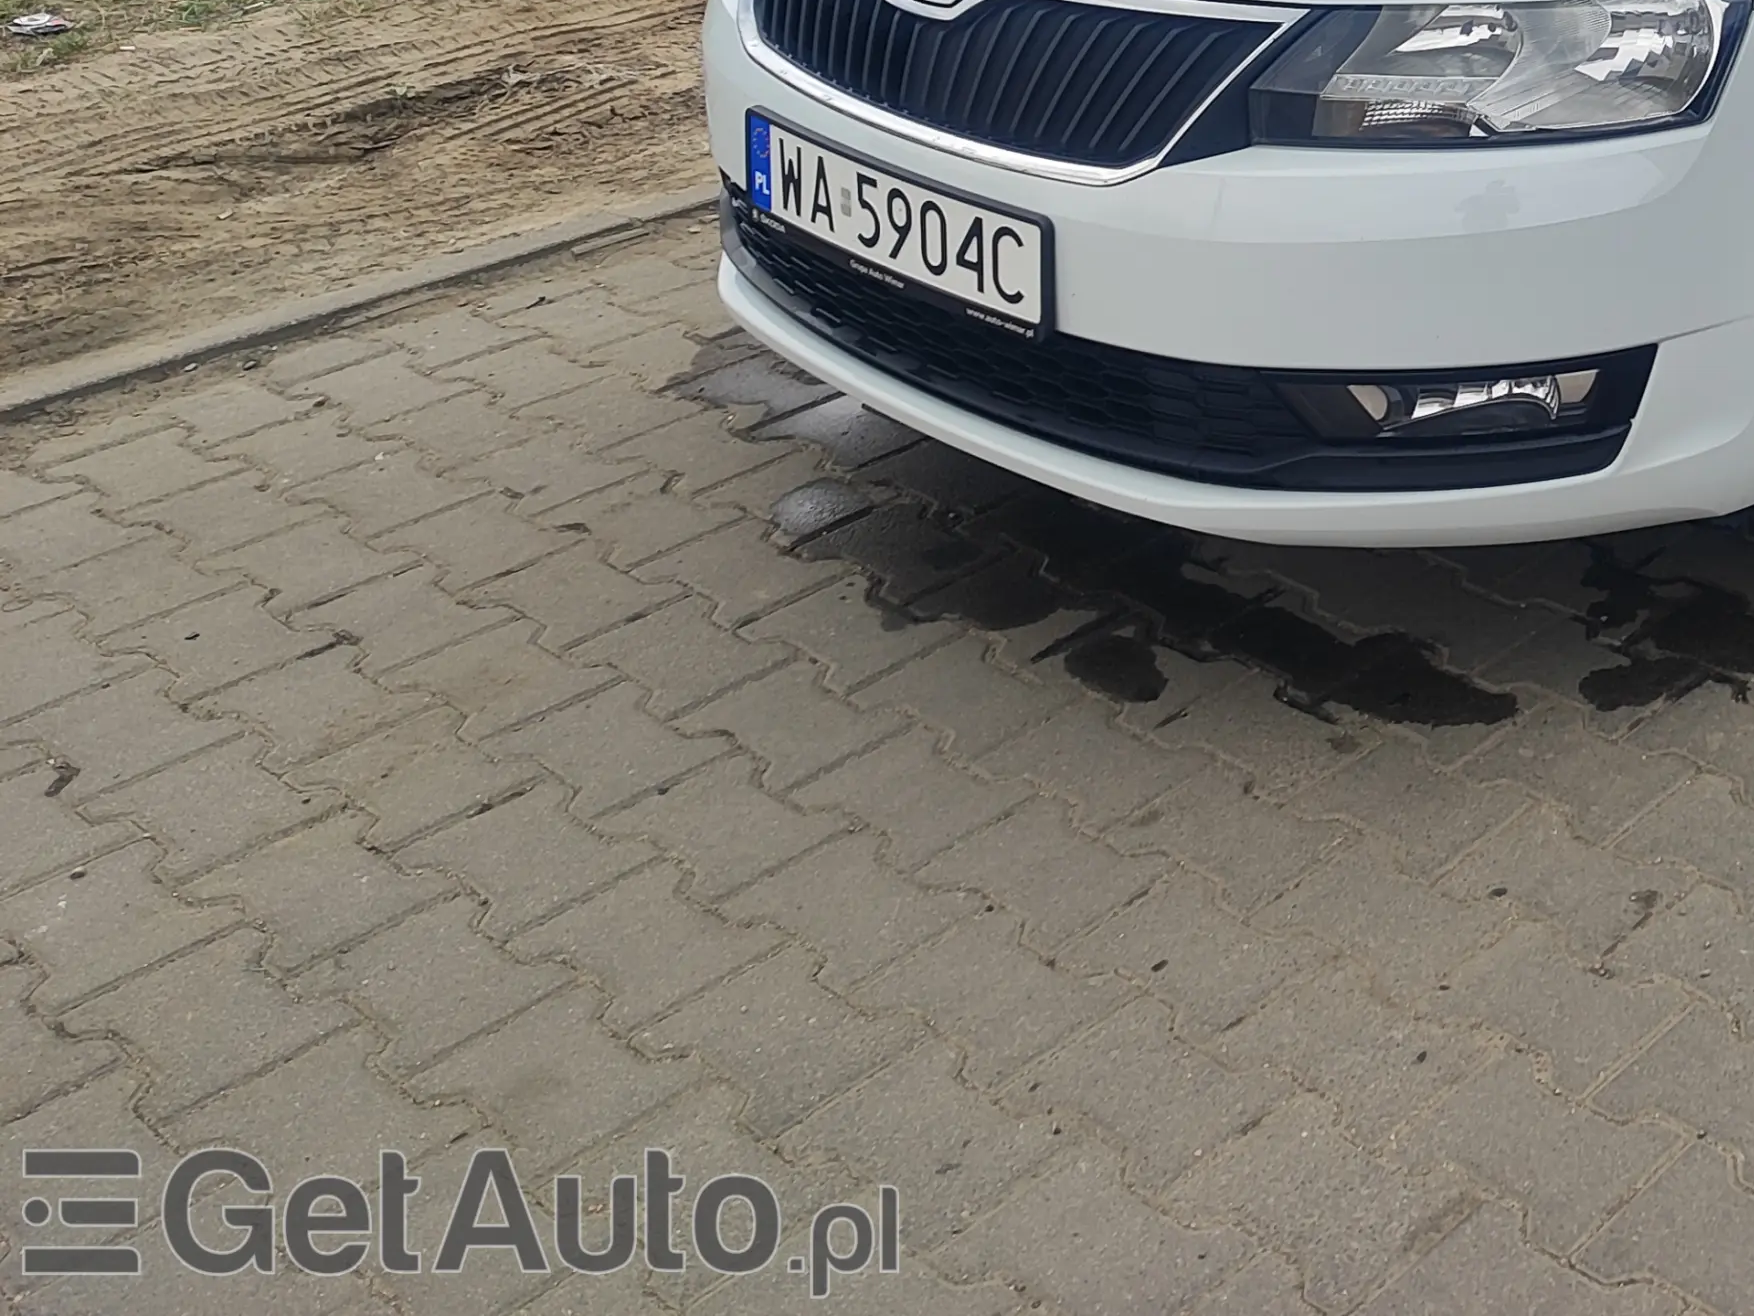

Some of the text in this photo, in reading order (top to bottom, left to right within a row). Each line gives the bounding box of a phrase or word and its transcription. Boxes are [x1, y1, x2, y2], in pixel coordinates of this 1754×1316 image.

[754, 170, 770, 196] PL
[778, 137, 1024, 305] WA 5904C
